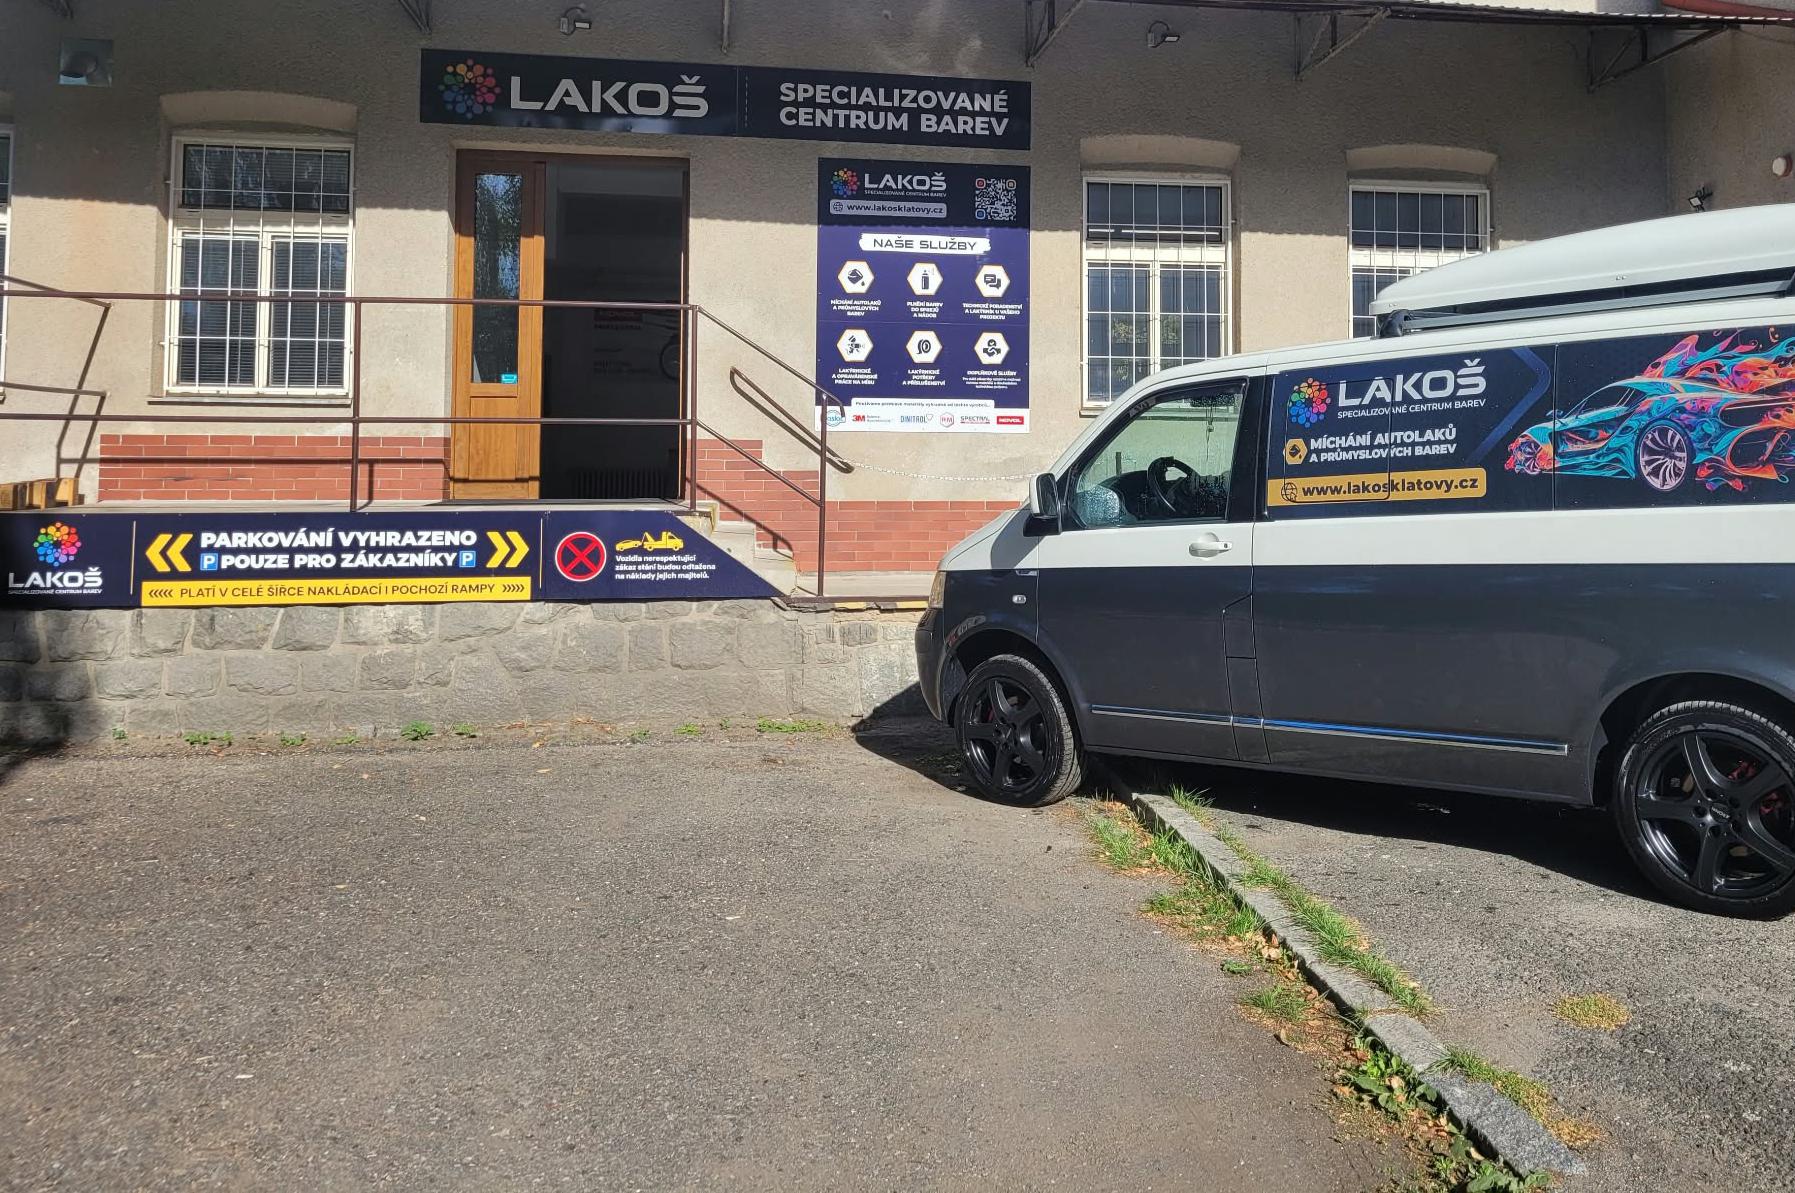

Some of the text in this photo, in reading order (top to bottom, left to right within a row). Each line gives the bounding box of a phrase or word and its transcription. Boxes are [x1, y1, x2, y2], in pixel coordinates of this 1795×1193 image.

[511, 75, 708, 118] LAKOŠ
[780, 83, 1009, 112] SPECIALIZOVANÉ
[780, 106, 1009, 136] CENTRUM BAREV
[864, 172, 947, 191] LAKOŠ
[847, 204, 943, 214] www.lakosklatovy.cz
[873, 236, 977, 250] NAŠE SLUŽBY
[1338, 358, 1487, 407] LAKOŠ
[1338, 399, 1486, 419] SPECIALIZOVANÉ CENTRUM BAREV
[900, 415, 927, 423] DINITROL
[1310, 423, 1457, 450] MÍCHÁNÍ AUTOLAKŮ
[1309, 444, 1457, 463] A PRŮMYSLOVÝCH BAREV
[1302, 478, 1479, 496] www.lakosklatovy.cz
[201, 527, 477, 548] PARKOVÁNÍ VYHRAZENO
[221, 554, 289, 569] POUZE
[294, 554, 336, 568] PRO
[340, 550, 457, 568] ZÁKAZNÍKY
[9, 567, 103, 588] LAKOŠ
[180, 585, 216, 598] PLATÍ
[217, 587, 228, 597] V
[232, 585, 263, 597] CELÉ
[267, 584, 304, 596] ŠÍŘCE
[308, 583, 382, 596] NAKLÁDACÍ
[392, 582, 448, 594] POCHOZÍ
[451, 584, 495, 594] RAMPY
